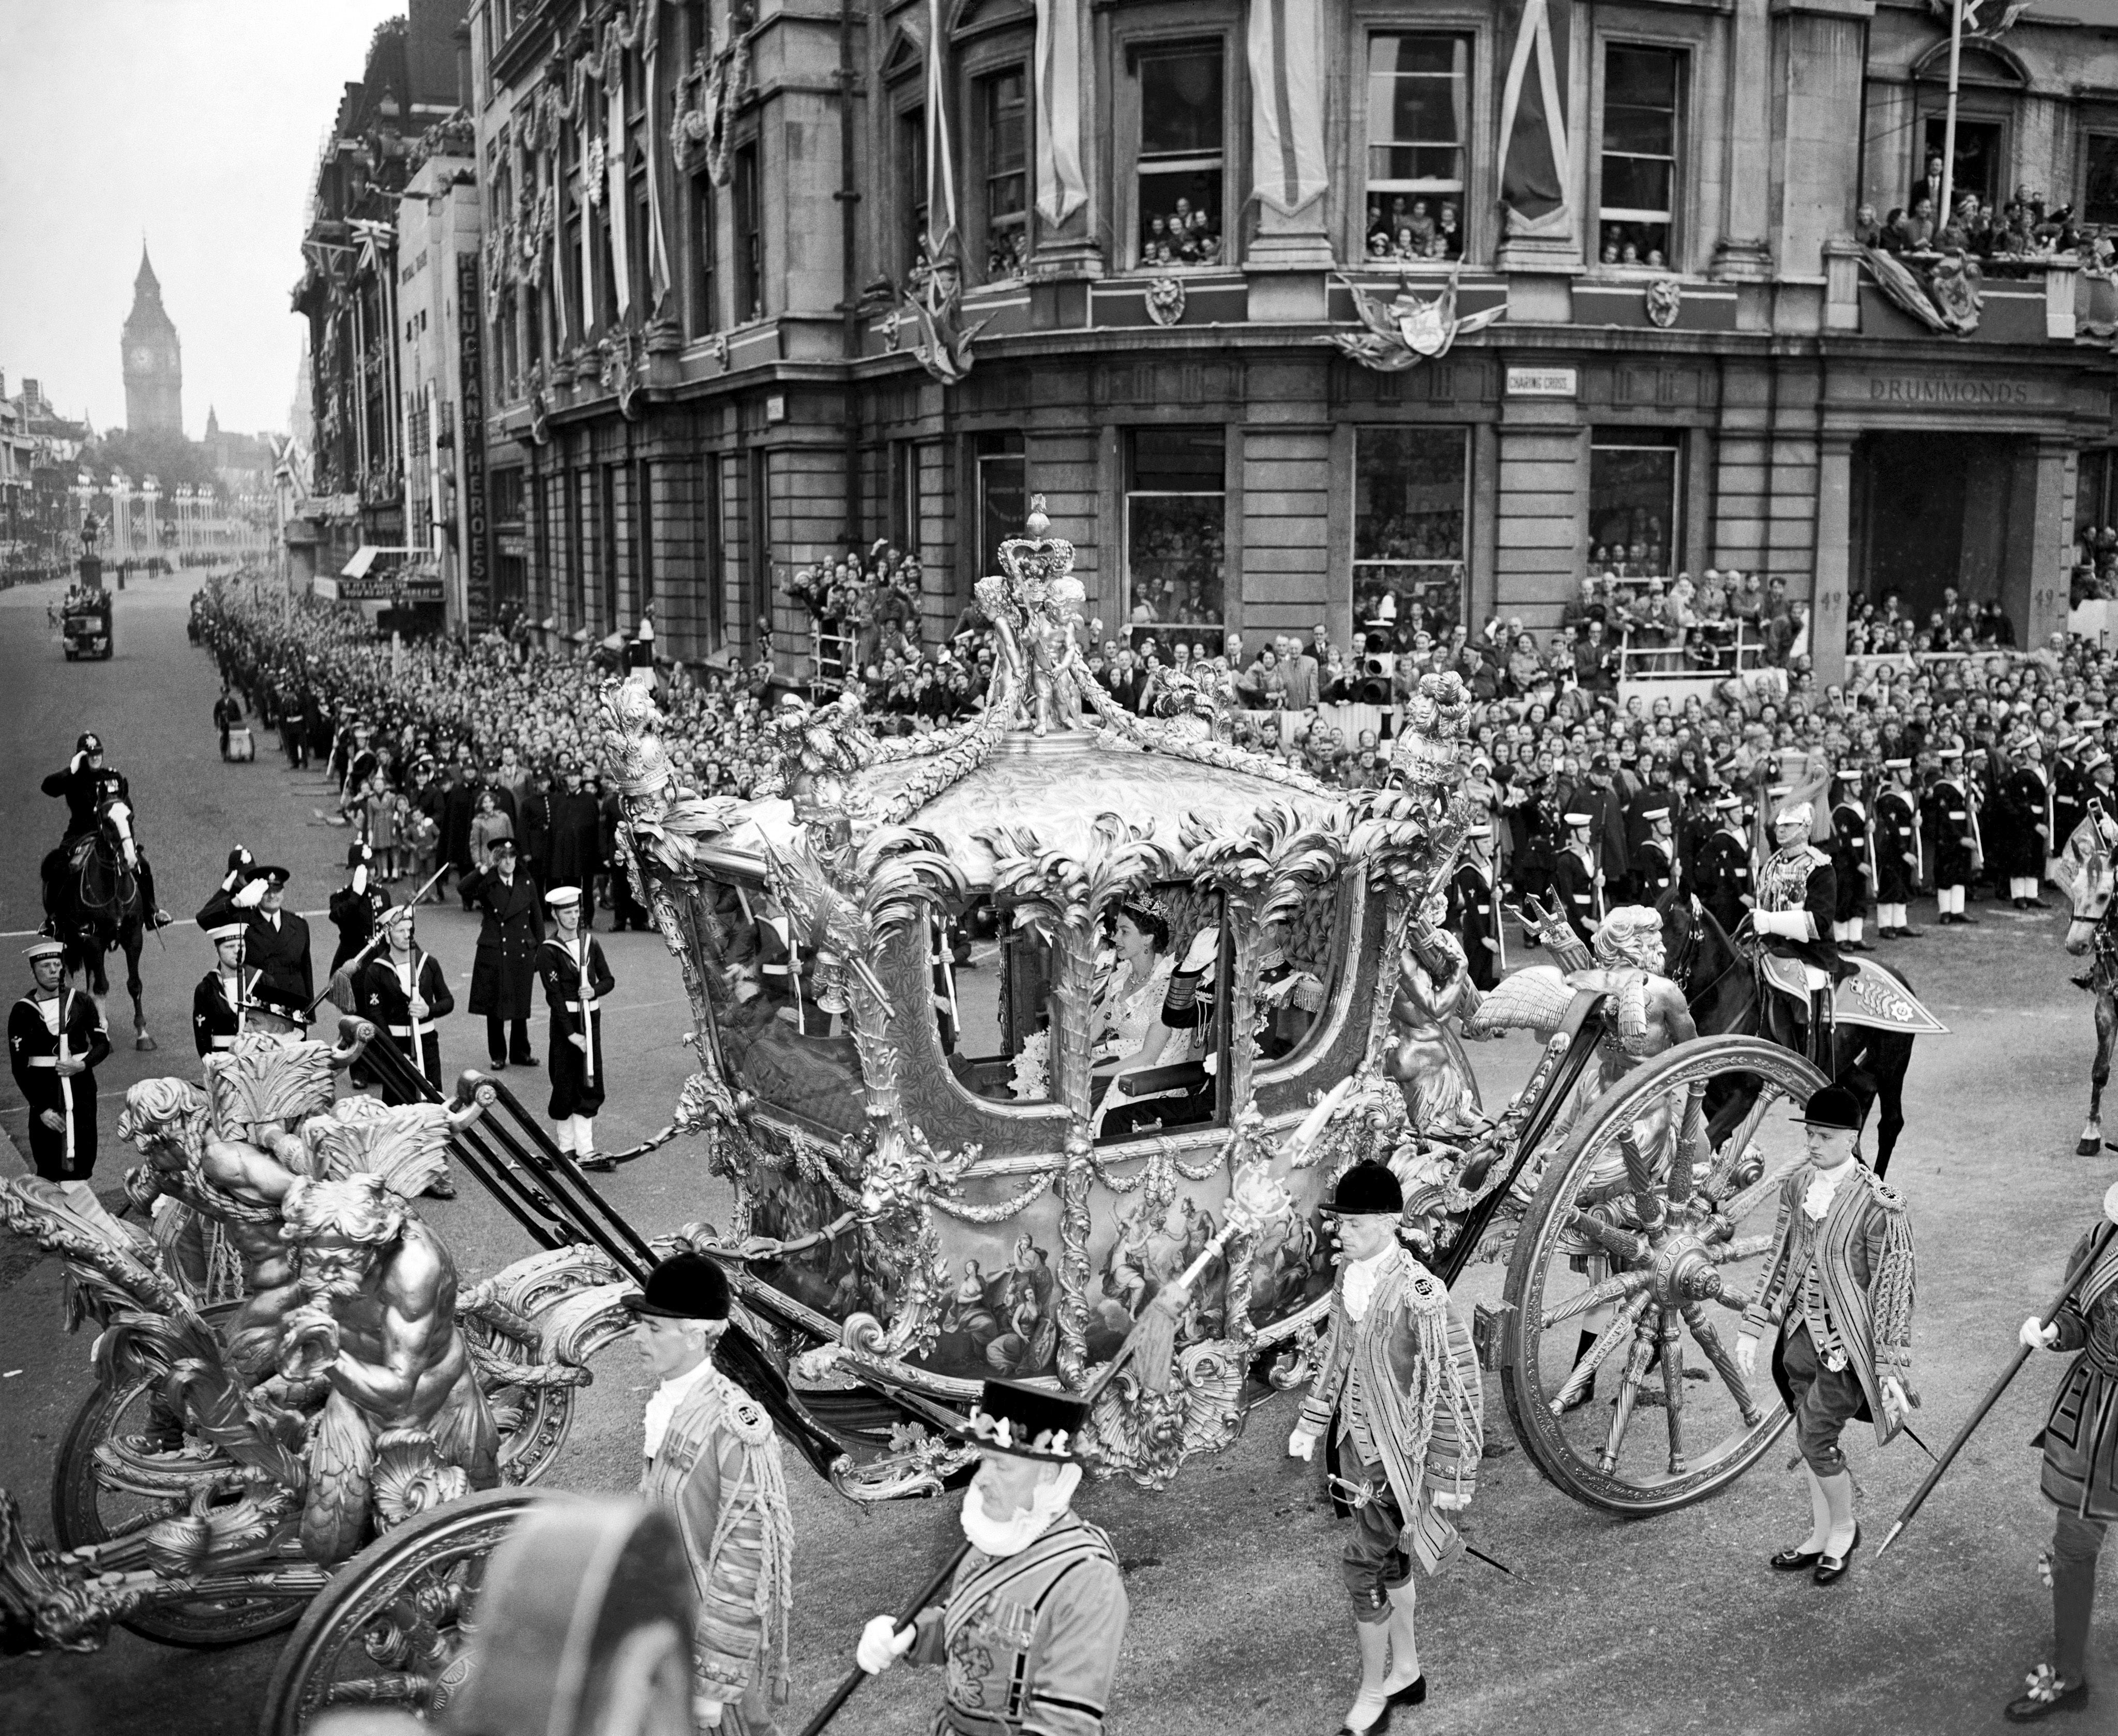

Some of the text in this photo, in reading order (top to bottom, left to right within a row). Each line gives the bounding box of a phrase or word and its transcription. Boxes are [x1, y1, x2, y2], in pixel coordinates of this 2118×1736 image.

[459, 252, 480, 438] RELUCTANT
[1508, 377, 1542, 389] CHARING
[1870, 379, 2026, 405] DRUMMONDS
[467, 453, 485, 577] HEROES
[1821, 591, 1841, 612] 49
[2035, 589, 2053, 608] 49
[1415, 1281, 1432, 1294] ER
